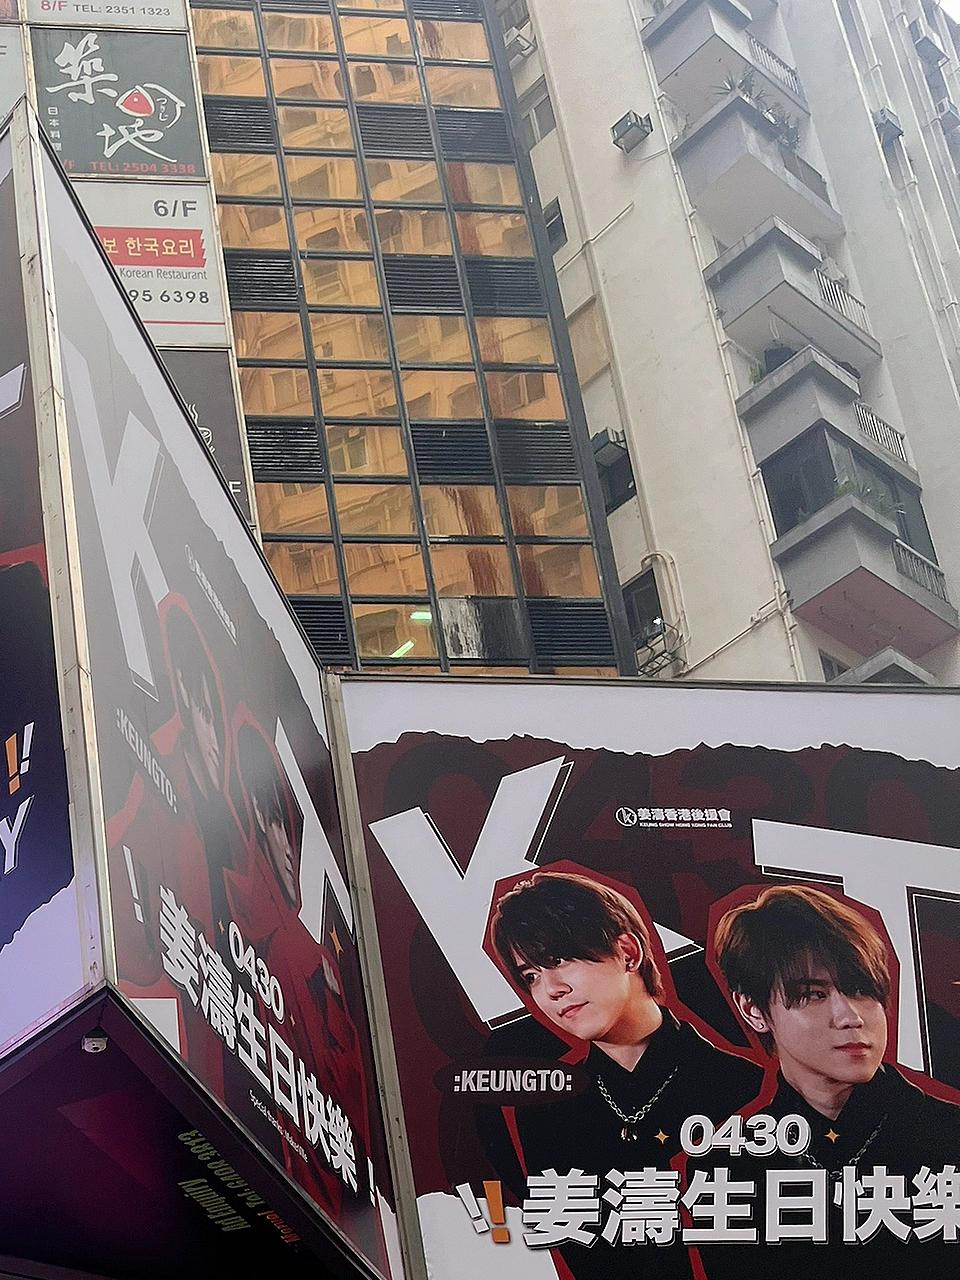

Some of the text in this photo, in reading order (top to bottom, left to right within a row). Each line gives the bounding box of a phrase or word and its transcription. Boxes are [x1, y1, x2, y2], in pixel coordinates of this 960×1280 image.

[74, 4, 102, 13] TEL:
[106, 5, 136, 14] 2351
[142, 7, 171, 16] 1323
[153, 199, 197, 217] 6/F
[125, 236, 195, 258] 한국요리
[119, 267, 208, 280] Korean Restaurant
[159, 290, 210, 303] 6398
[228, 920, 286, 1025] 0430
[158, 884, 359, 1194] 姜濤生日快樂
[680, 1114, 811, 1156] 0430
